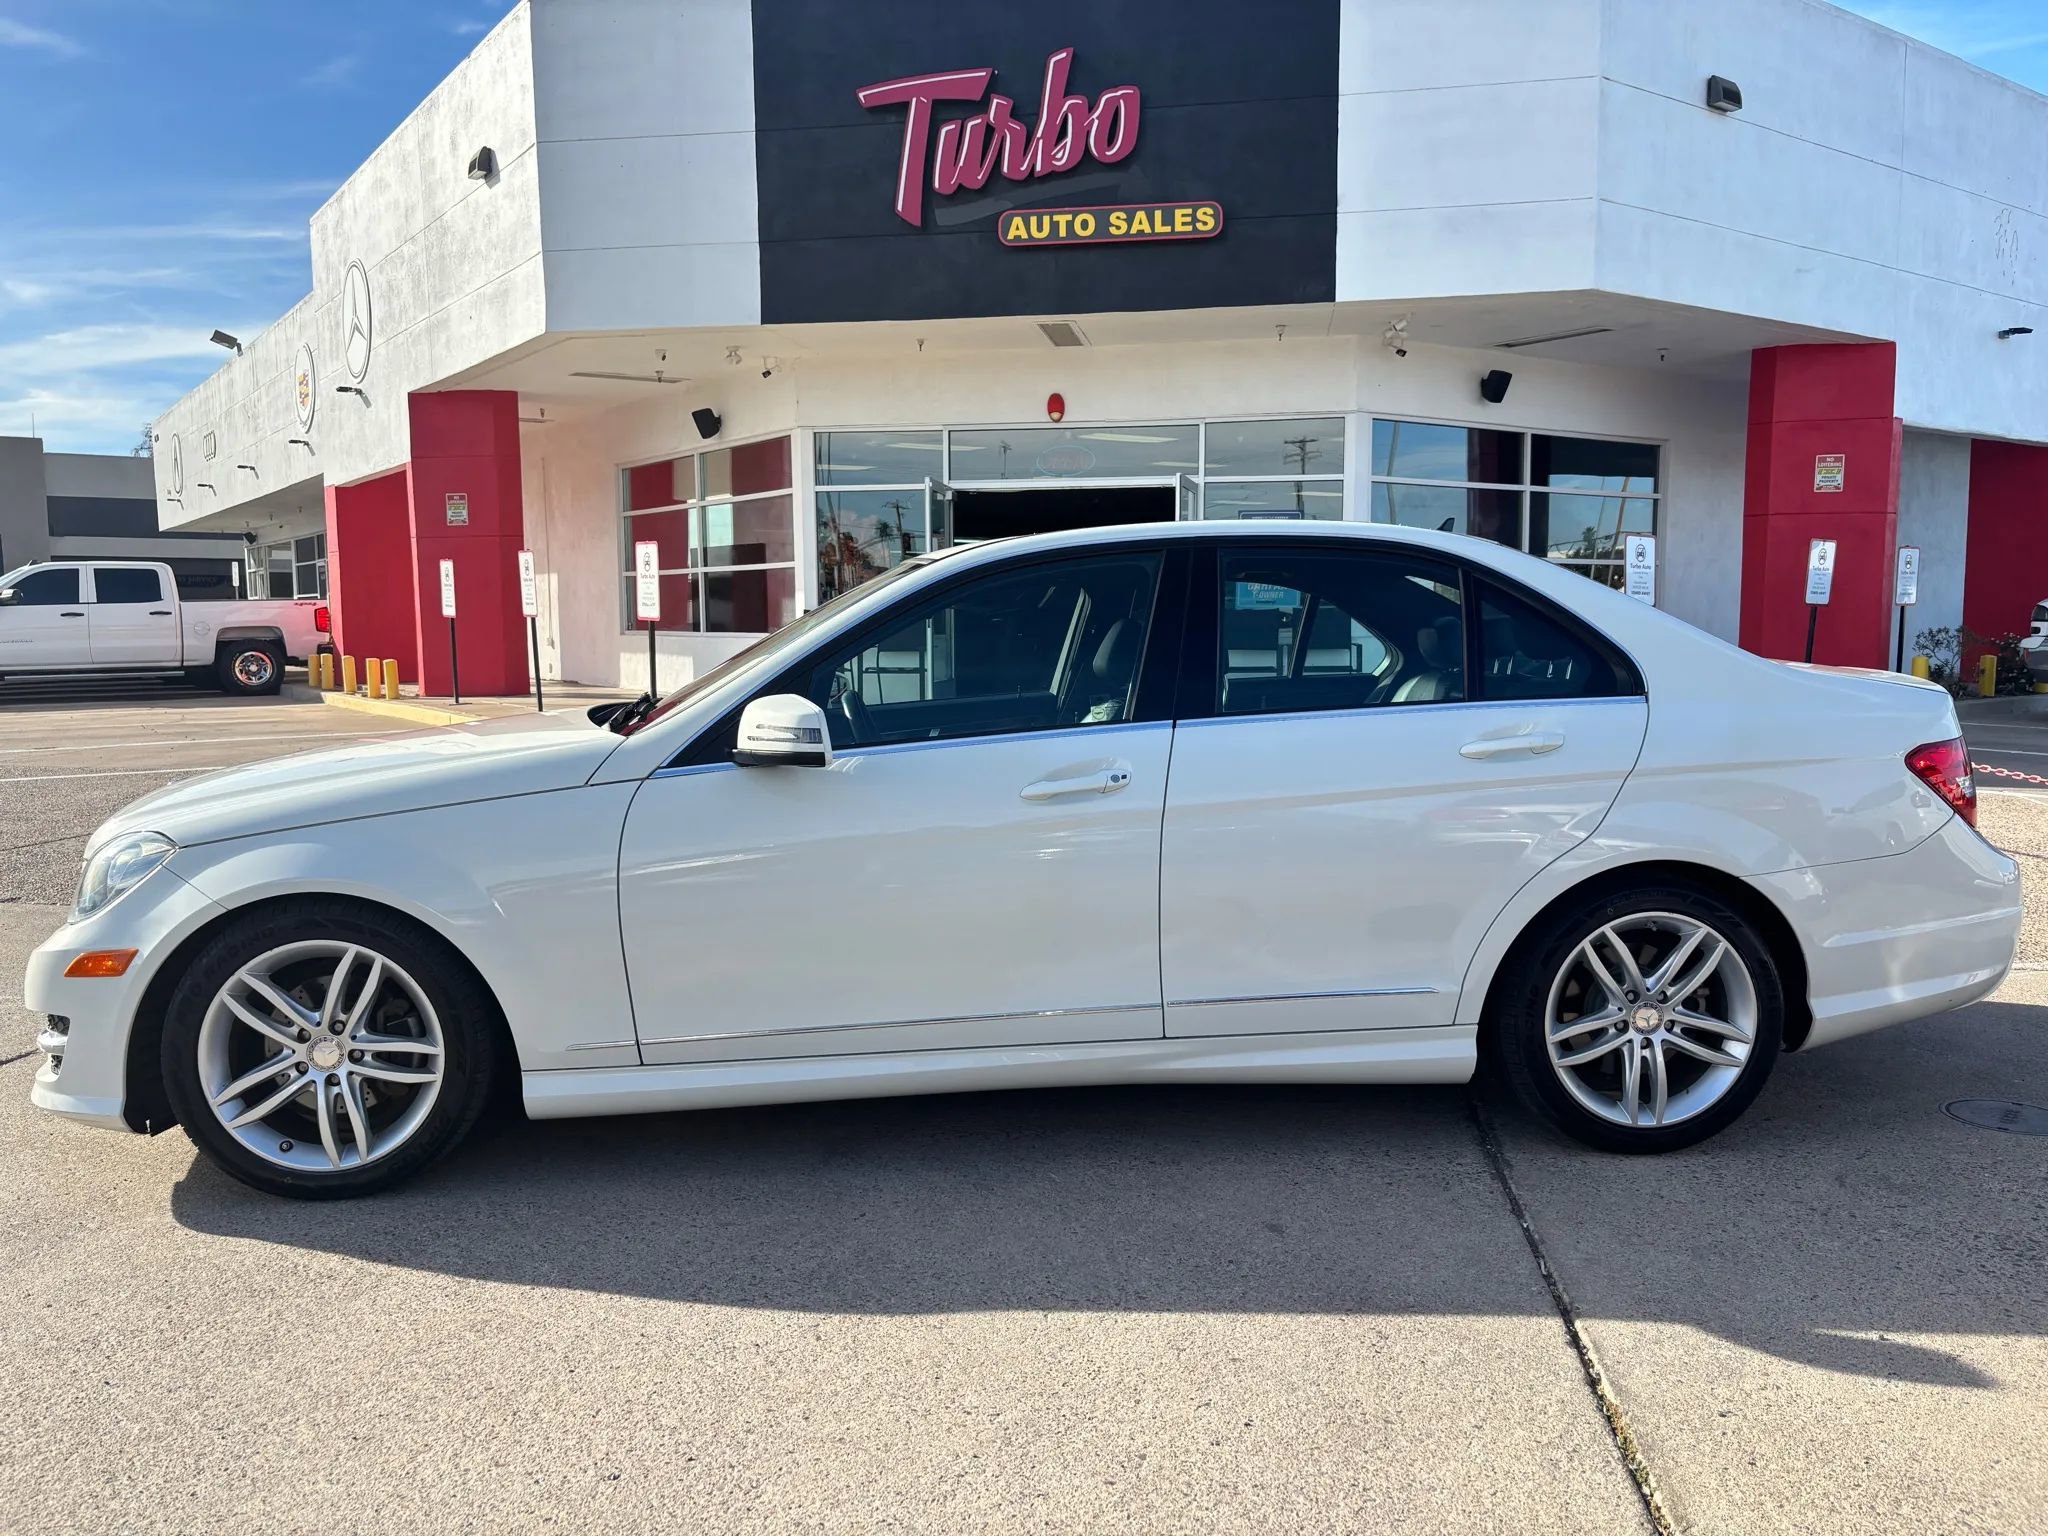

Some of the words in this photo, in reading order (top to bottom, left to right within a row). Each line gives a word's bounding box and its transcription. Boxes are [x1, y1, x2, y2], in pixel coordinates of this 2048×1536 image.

[856, 47, 1140, 227] Turbo
[1006, 213, 1096, 240] AUTO
[1108, 207, 1215, 235] SALES
